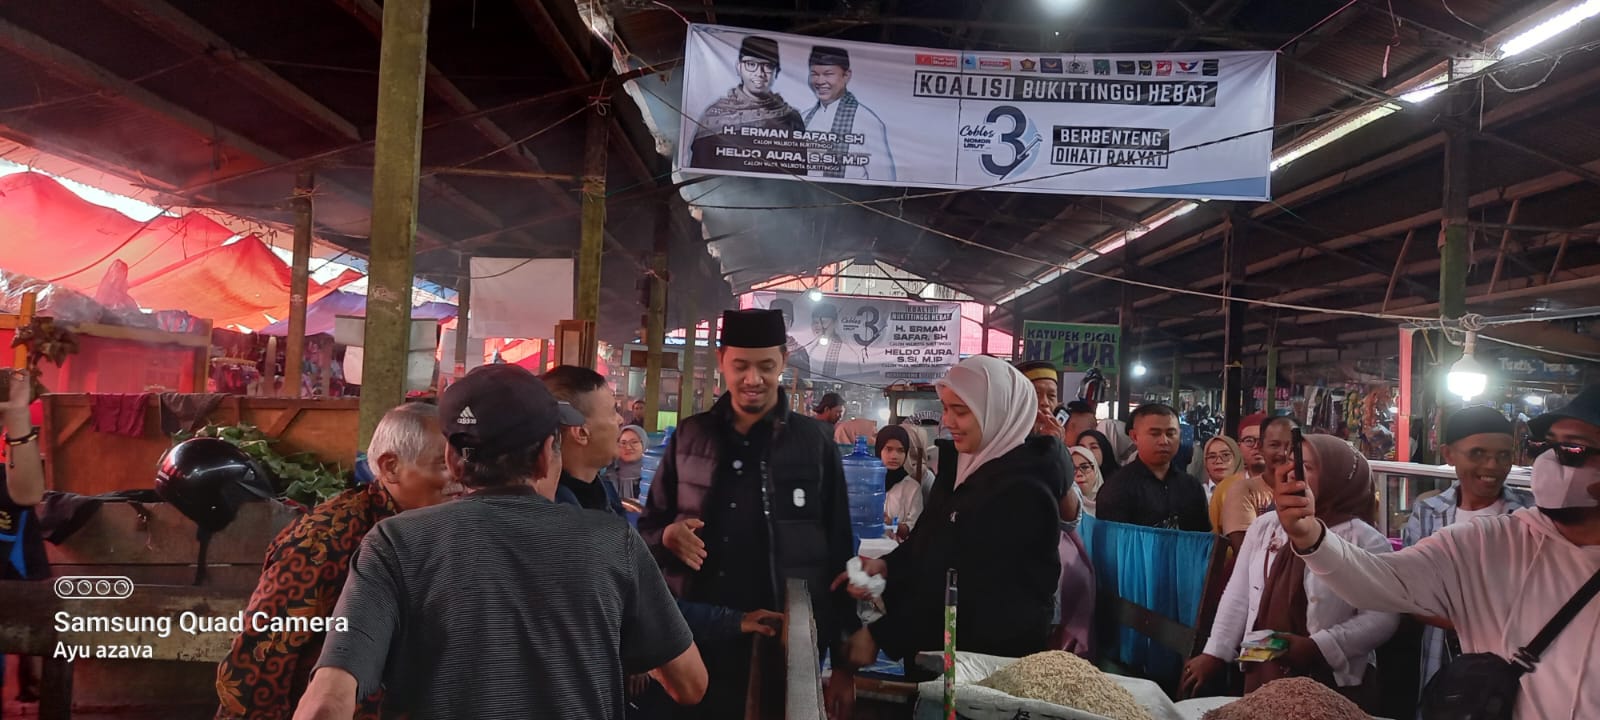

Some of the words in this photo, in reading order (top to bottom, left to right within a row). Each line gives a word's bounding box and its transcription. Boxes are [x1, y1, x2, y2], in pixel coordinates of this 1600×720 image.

[920, 74, 1011, 98] KOALISI
[1022, 79, 1141, 101] BUKITTINGGI
[1149, 84, 1208, 103] HEBAT
[723, 126, 737, 135] H.
[741, 127, 789, 139] ERMAN
[793, 130, 840, 143] SAFAR,
[844, 134, 864, 144] SH
[960, 125, 995, 138] Coblos
[1060, 128, 1162, 146] BERBENTENG
[981, 105, 1027, 177] 3
[716, 147, 761, 158] HELDO
[842, 154, 869, 166] M.IP
[1055, 147, 1102, 164] DIHATI
[1107, 149, 1165, 166] RAKYAT
[853, 305, 880, 346] 3
[896, 325, 906, 333] H.
[909, 325, 946, 333] ERMAN
[1027, 328, 1080, 341] KATUPEK
[1084, 332, 1116, 343] PICAL
[1025, 339, 1052, 360] NI
[1063, 341, 1115, 368] NUR
[457, 417, 477, 425] adidas
